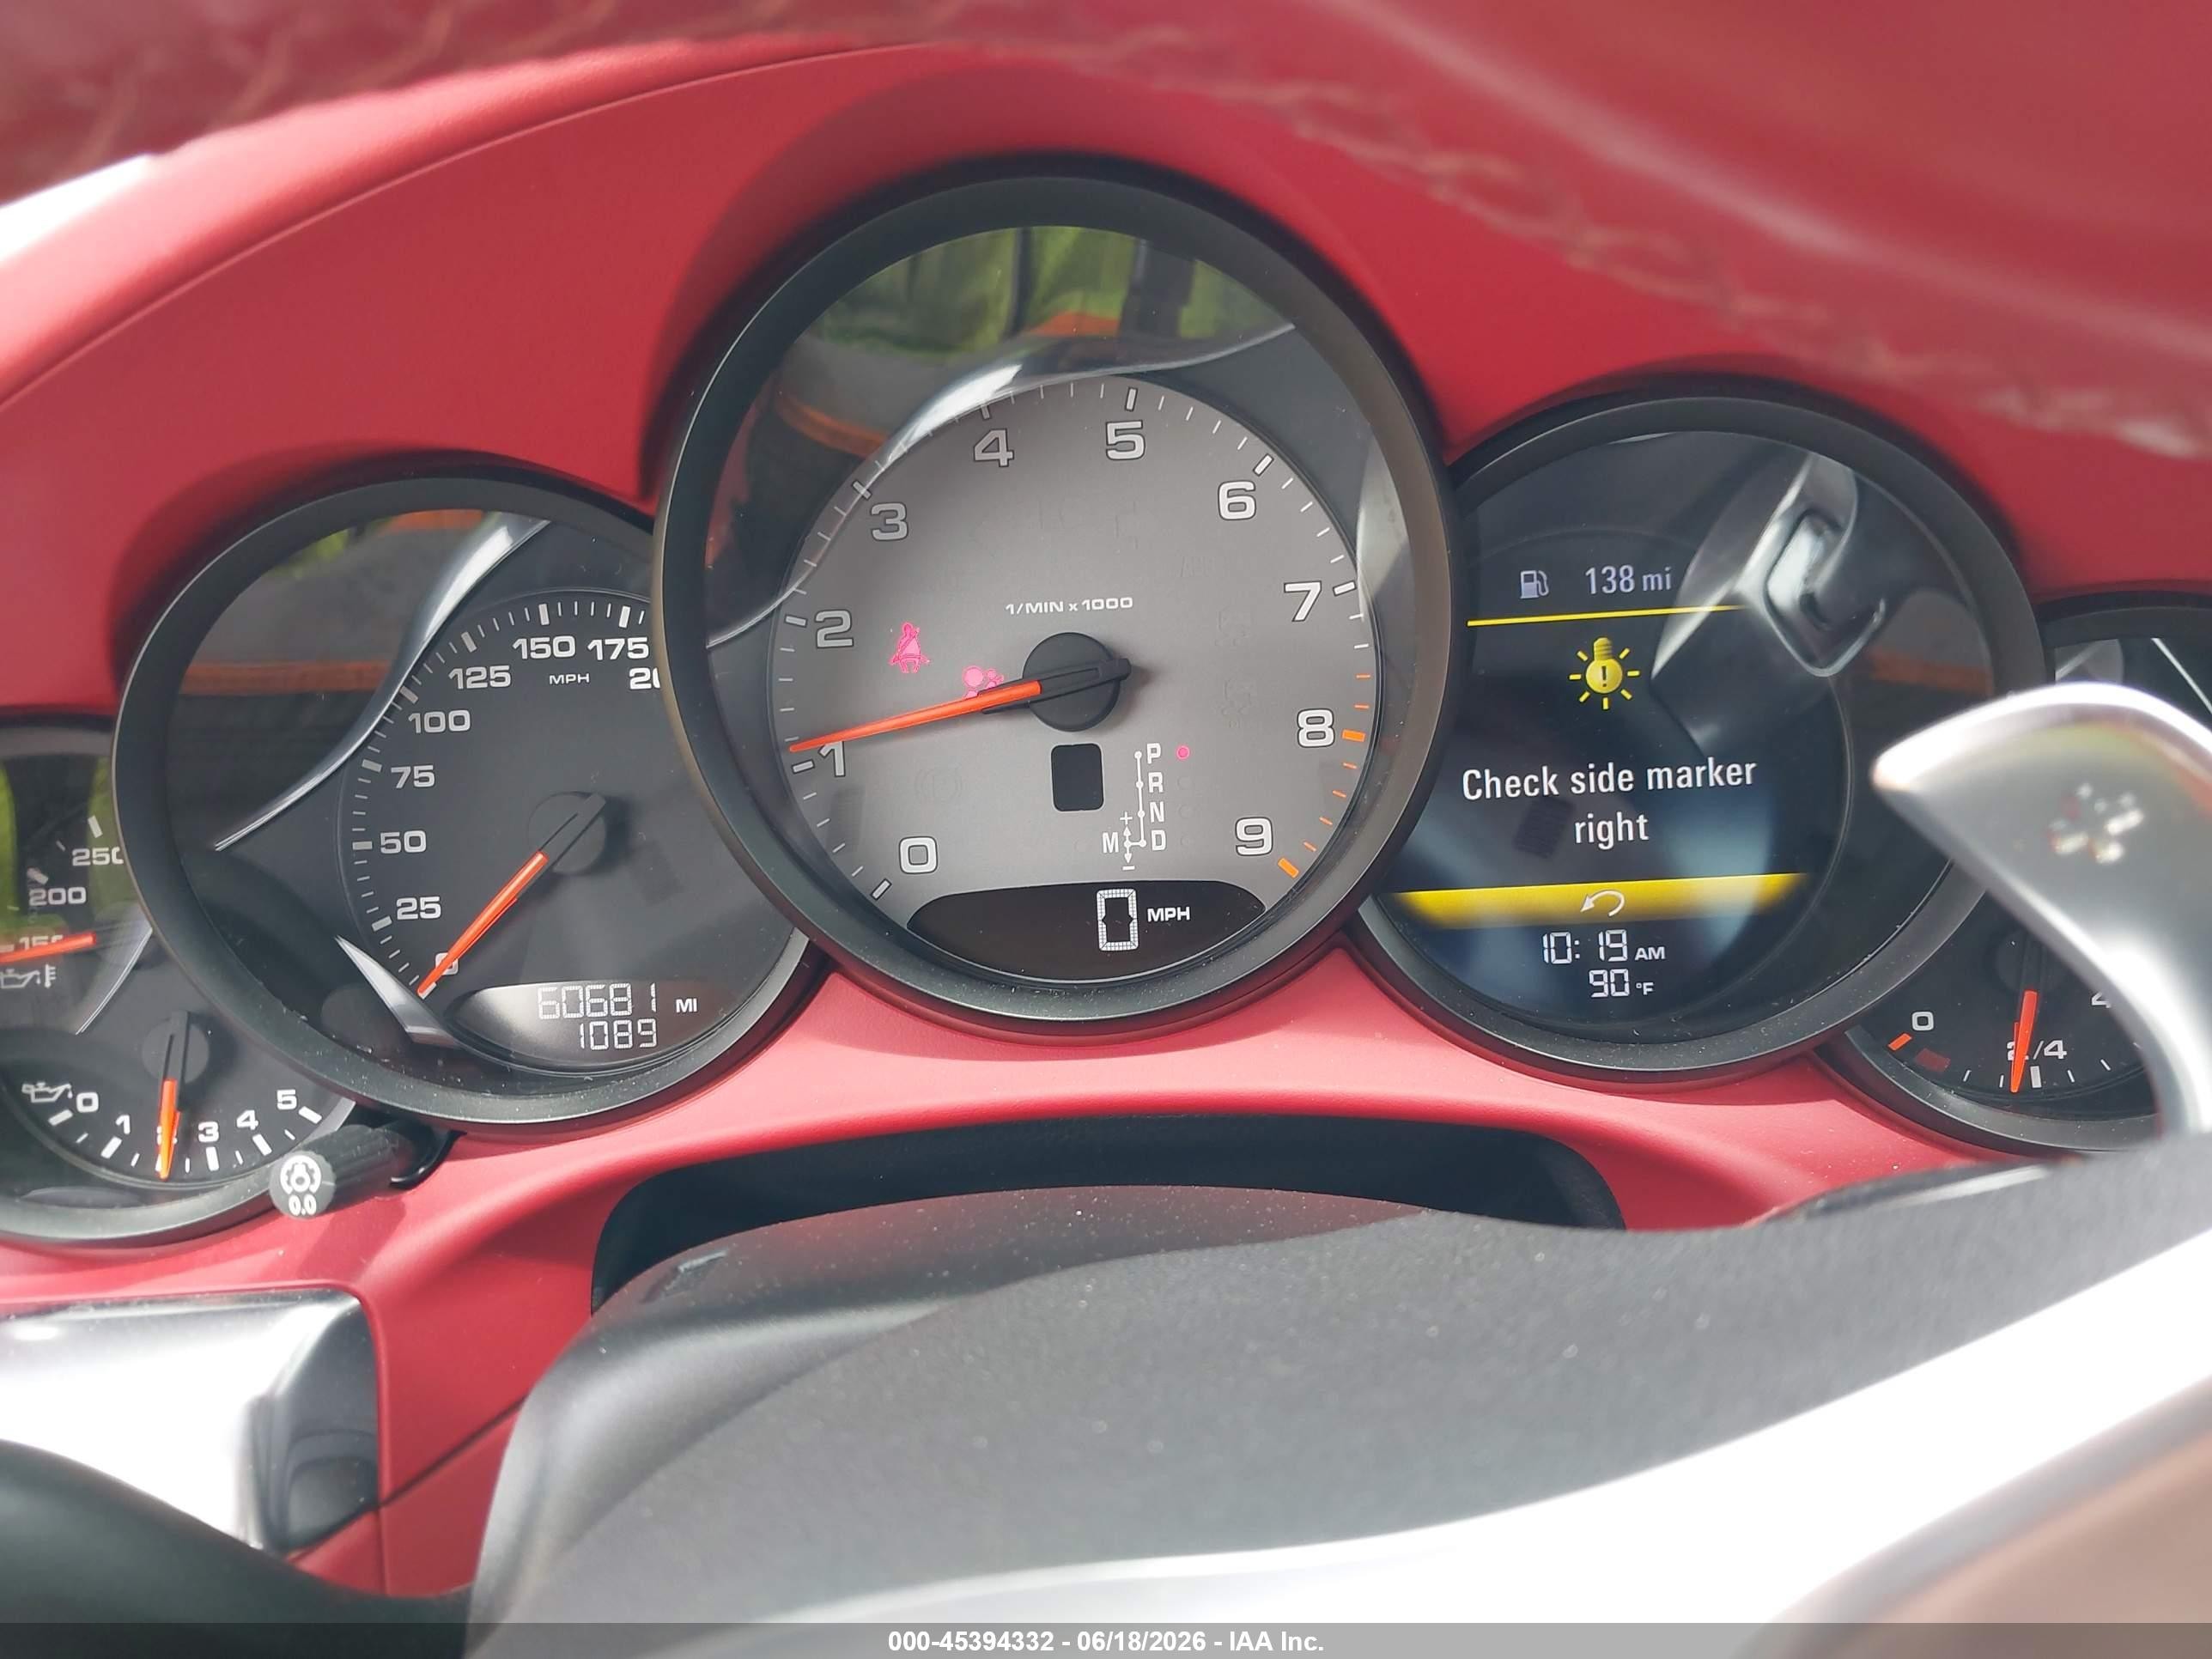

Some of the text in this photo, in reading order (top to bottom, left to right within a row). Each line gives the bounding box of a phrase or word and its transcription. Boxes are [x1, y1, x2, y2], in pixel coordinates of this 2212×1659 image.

[973, 428, 1013, 466] 4
[1107, 421, 1147, 459] 5
[1218, 481, 1255, 520] 6
[871, 502, 908, 541] 3
[1585, 565, 1671, 594] 138 mi
[1006, 600, 1064, 615] 1/MIN
[1081, 597, 1133, 611] 1000
[1285, 581, 1321, 621] 7
[816, 611, 853, 648] 2
[513, 636, 576, 659] 150
[587, 637, 649, 659] 175
[448, 665, 512, 690] 125
[549, 672, 590, 685] MPH
[408, 709, 471, 733] 100
[1297, 709, 1334, 747] 8
[819, 740, 846, 776] 1
[1146, 743, 1161, 764] P
[391, 764, 435, 789] 75
[1148, 771, 1164, 793] R
[1462, 757, 1757, 800] Check side marker
[1149, 800, 1164, 823] N
[380, 830, 427, 854] 50
[1102, 831, 1119, 854] M
[1151, 830, 1166, 851] D
[1235, 817, 1273, 855] 9
[1575, 811, 1649, 850] right
[899, 836, 938, 874] 0
[29, 886, 87, 907] 200
[396, 896, 441, 921] 25
[1096, 888, 1139, 951] 0
[1147, 906, 1191, 922] MPH
[1542, 929, 1666, 964] 10:19 AM
[1589, 968, 1630, 998] 90
[538, 981, 698, 1020] 60681 MI
[1911, 1011, 1935, 1031] 0
[579, 1018, 657, 1050] 1089
[76, 1091, 100, 1114] 0
[276, 1089, 297, 1110] 5
[115, 1115, 131, 1134] 1
[198, 1121, 220, 1143] 3
[236, 1109, 259, 1131] 4
[288, 1194, 317, 1216] 0.0
